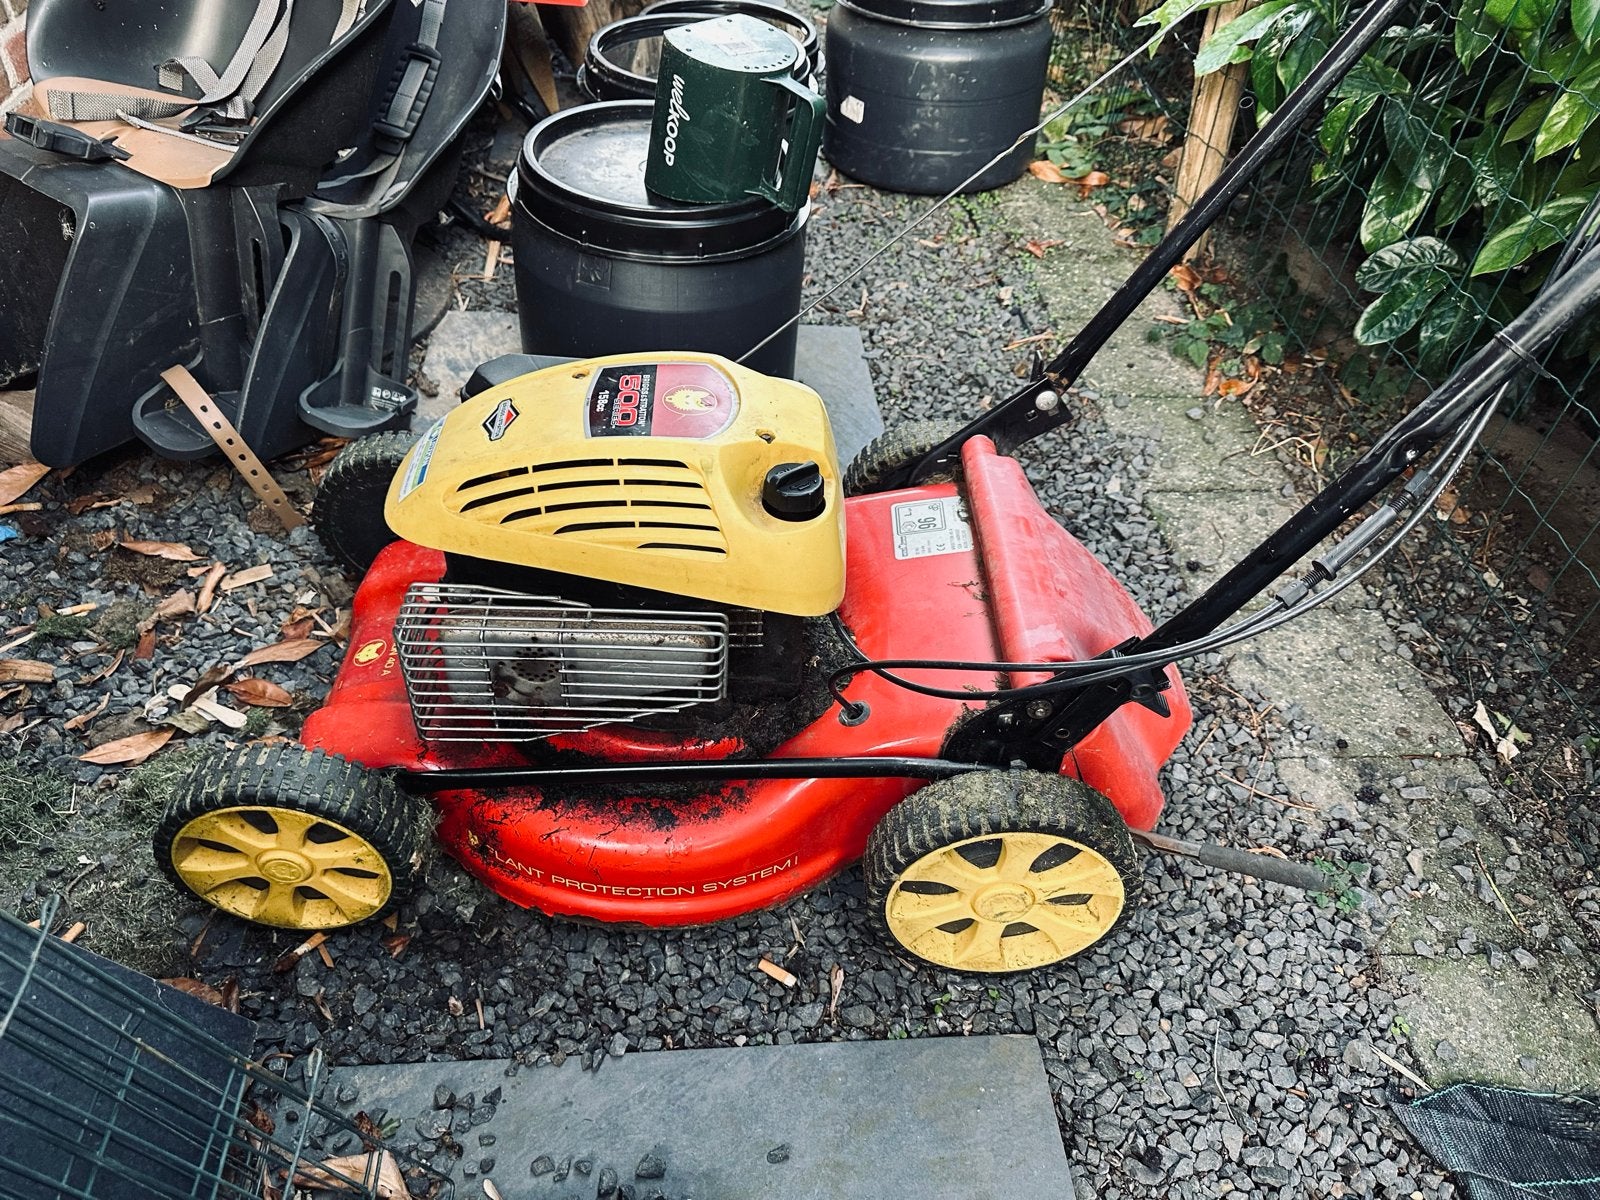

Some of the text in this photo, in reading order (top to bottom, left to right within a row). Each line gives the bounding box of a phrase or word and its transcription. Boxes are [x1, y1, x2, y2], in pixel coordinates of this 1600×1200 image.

[596, 390, 610, 412] 158cc
[617, 374, 641, 426] 500
[611, 398, 621, 426] SERIES
[918, 516, 937, 530] 96
[551, 875, 696, 897] PROTECTION
